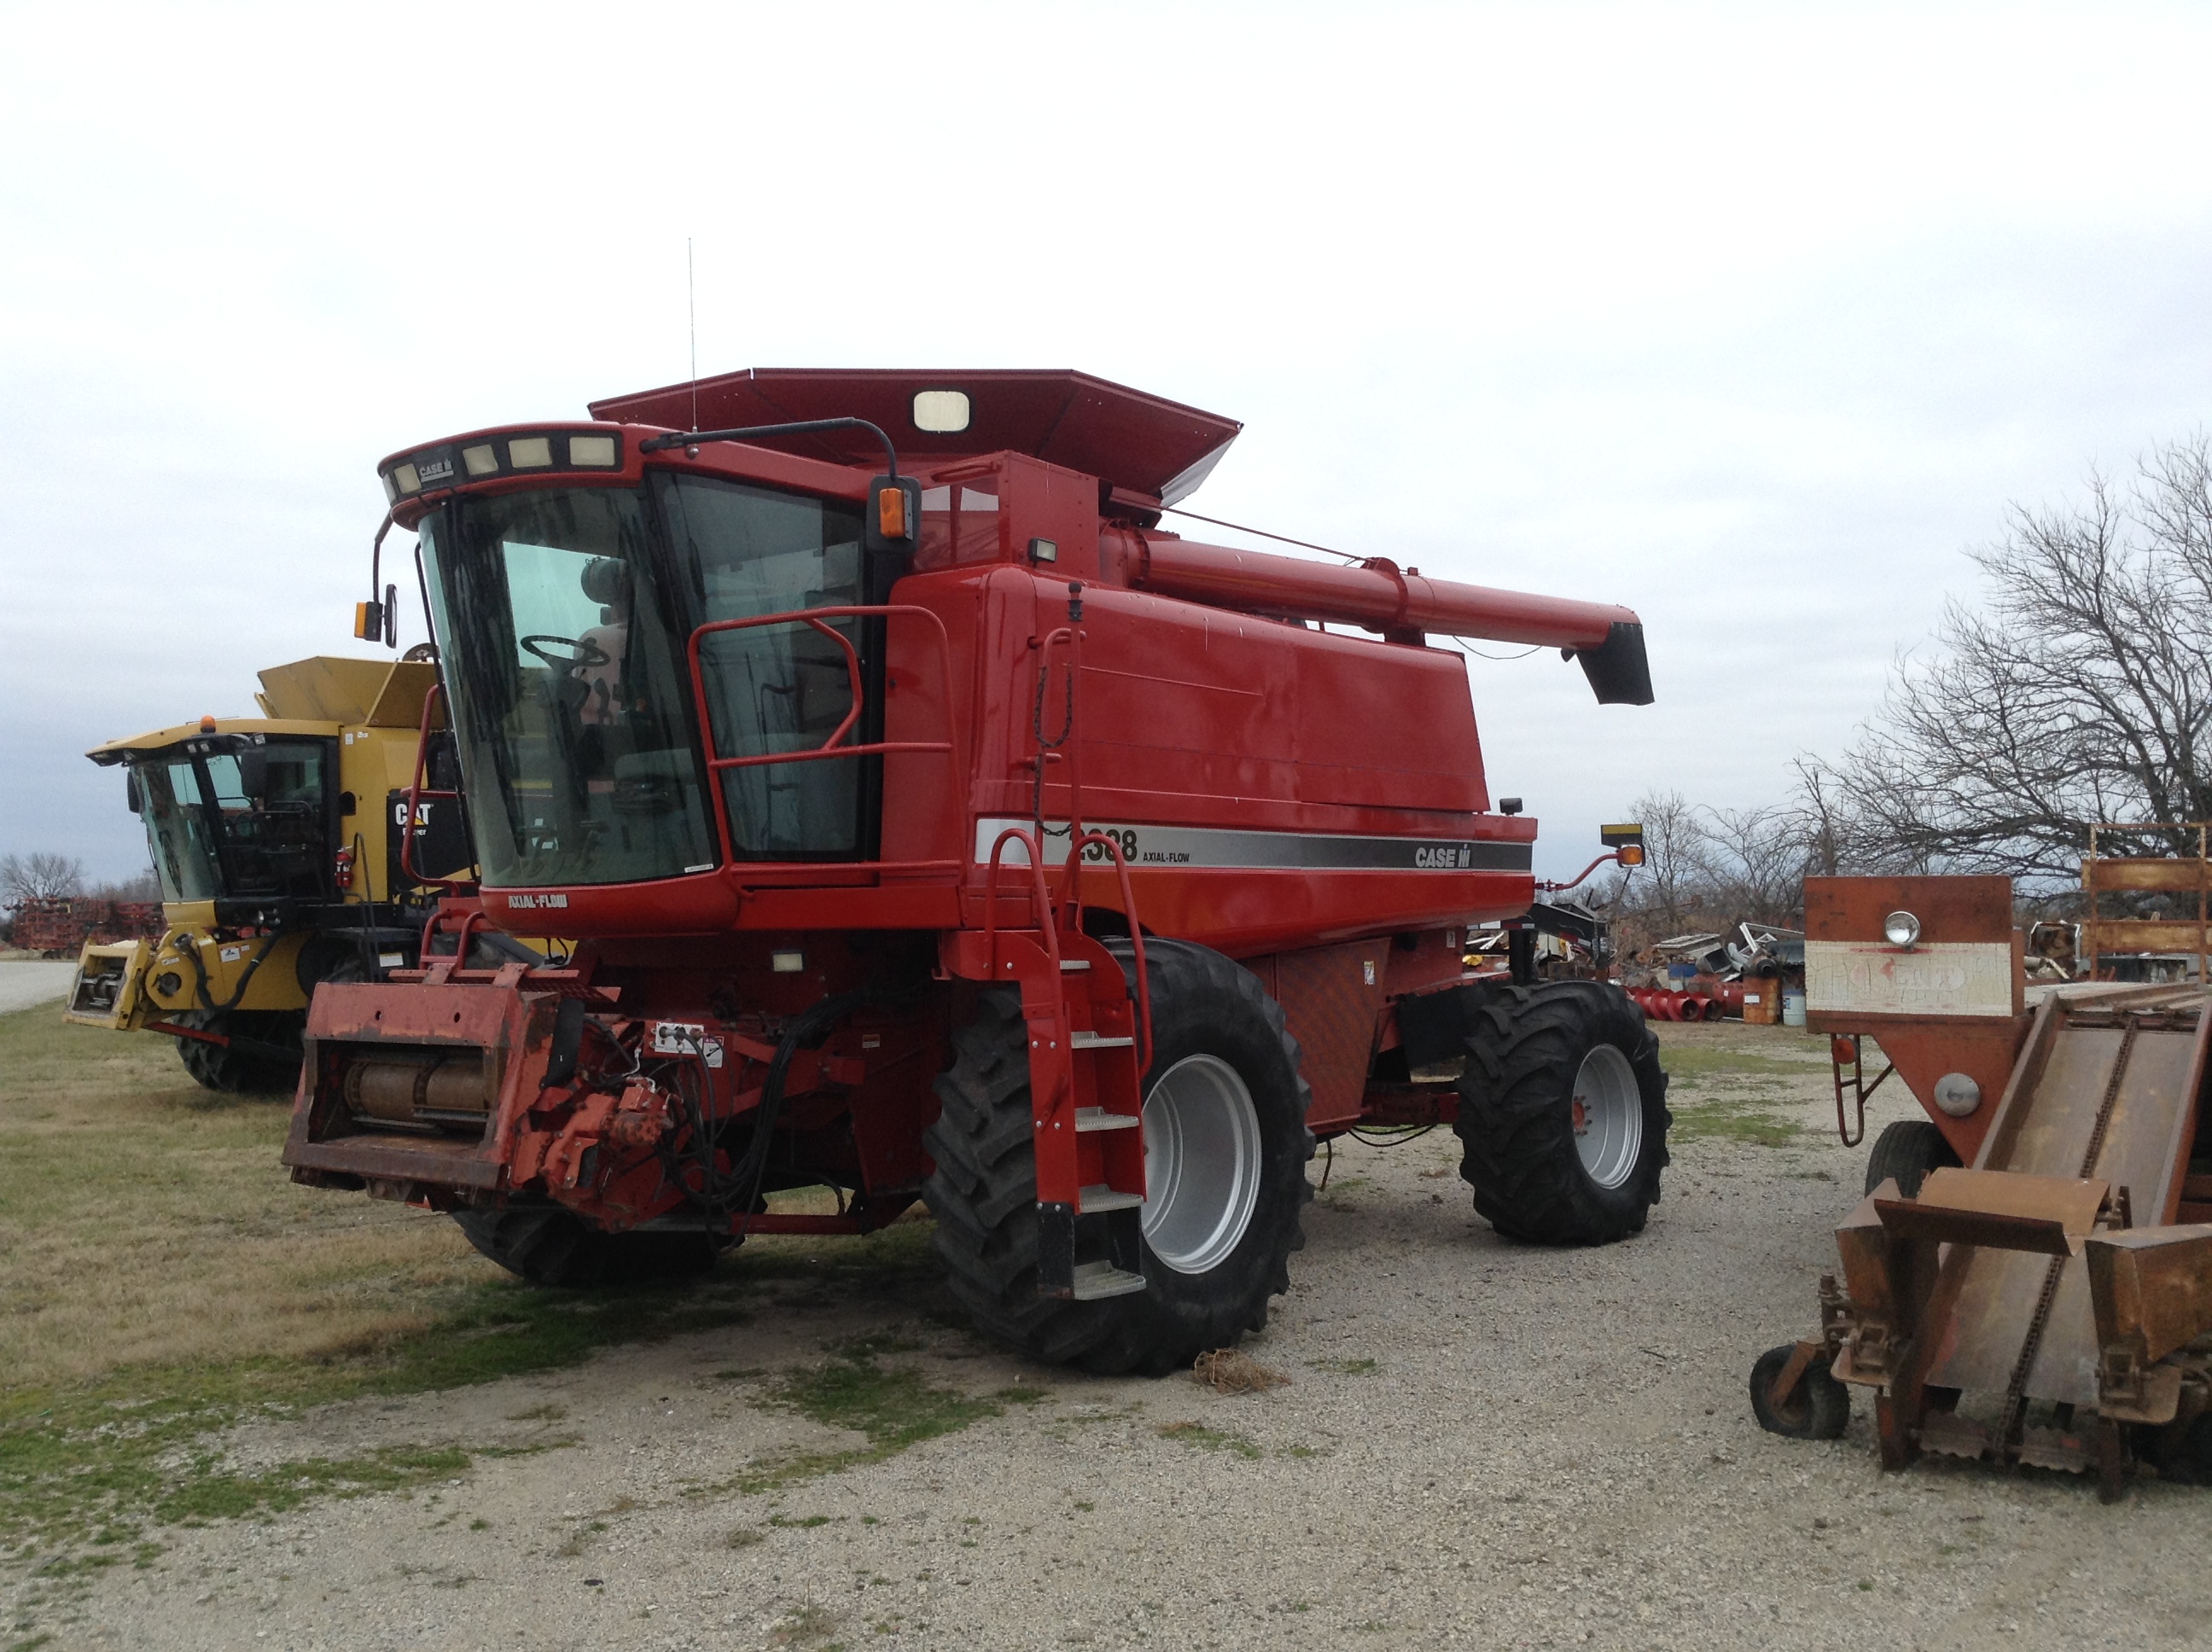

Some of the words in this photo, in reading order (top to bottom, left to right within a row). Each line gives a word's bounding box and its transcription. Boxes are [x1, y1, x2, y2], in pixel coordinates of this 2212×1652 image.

[419, 462, 444, 478] CASE
[1143, 852, 1190, 863] AXIAL-FLOW
[1415, 846, 1456, 868] CASE
